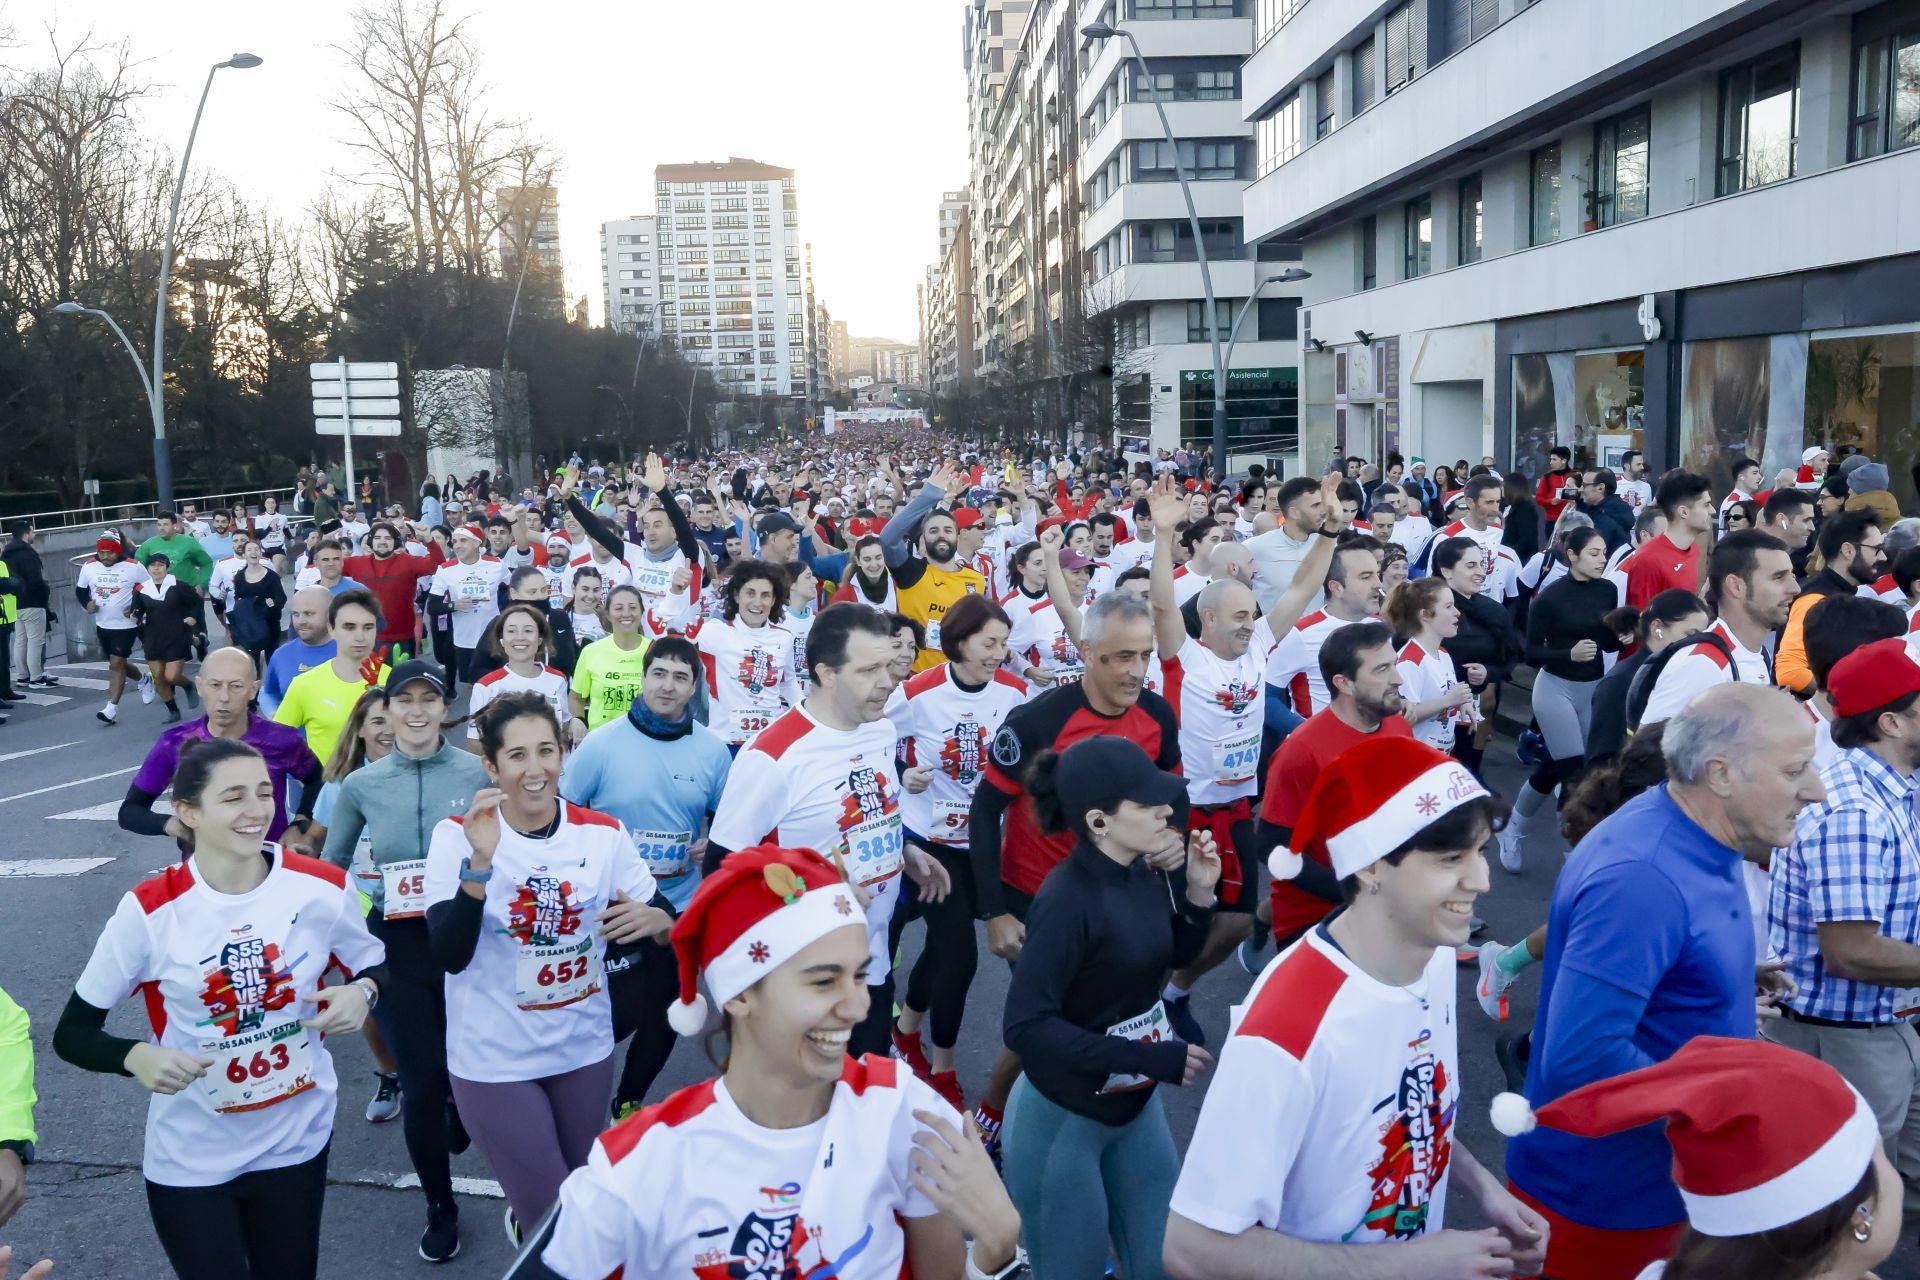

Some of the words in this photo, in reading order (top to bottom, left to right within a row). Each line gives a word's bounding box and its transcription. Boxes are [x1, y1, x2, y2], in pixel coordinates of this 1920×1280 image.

[1229, 369, 1270, 379] Asistencial
[1076, 549, 1085, 558] C
[639, 574, 666, 586] 4783
[462, 586, 485, 595] 4312
[928, 602, 949, 613] pu
[605, 671, 620, 680] 46
[741, 718, 769, 730] 329
[965, 723, 979, 733] 55
[959, 730, 979, 741] SAN
[960, 740, 979, 751] SIL
[960, 751, 979, 761] VES
[1223, 745, 1259, 769] 4741
[960, 760, 978, 771] TRE
[859, 769, 875, 785] 55
[854, 780, 879, 796] SAN
[860, 793, 883, 813] SIL
[860, 825, 868, 834] 55
[868, 821, 881, 832] SAN
[946, 813, 970, 829] 57
[397, 874, 425, 896] 65
[540, 878, 560, 890] 55
[537, 896, 564, 910] SIL
[536, 908, 562, 921] VES
[532, 920, 561, 938] TRE
[239, 941, 264, 958] 55
[547, 948, 565, 957] SAN
[227, 954, 265, 972] SAN
[537, 955, 588, 987] 652
[231, 968, 267, 989] SIL
[1129, 1020, 1143, 1031] SAN
[219, 1041, 231, 1050] 55
[231, 1036, 253, 1048] SAN
[253, 1019, 301, 1042] SILVESTRE
[226, 1043, 290, 1084] 663
